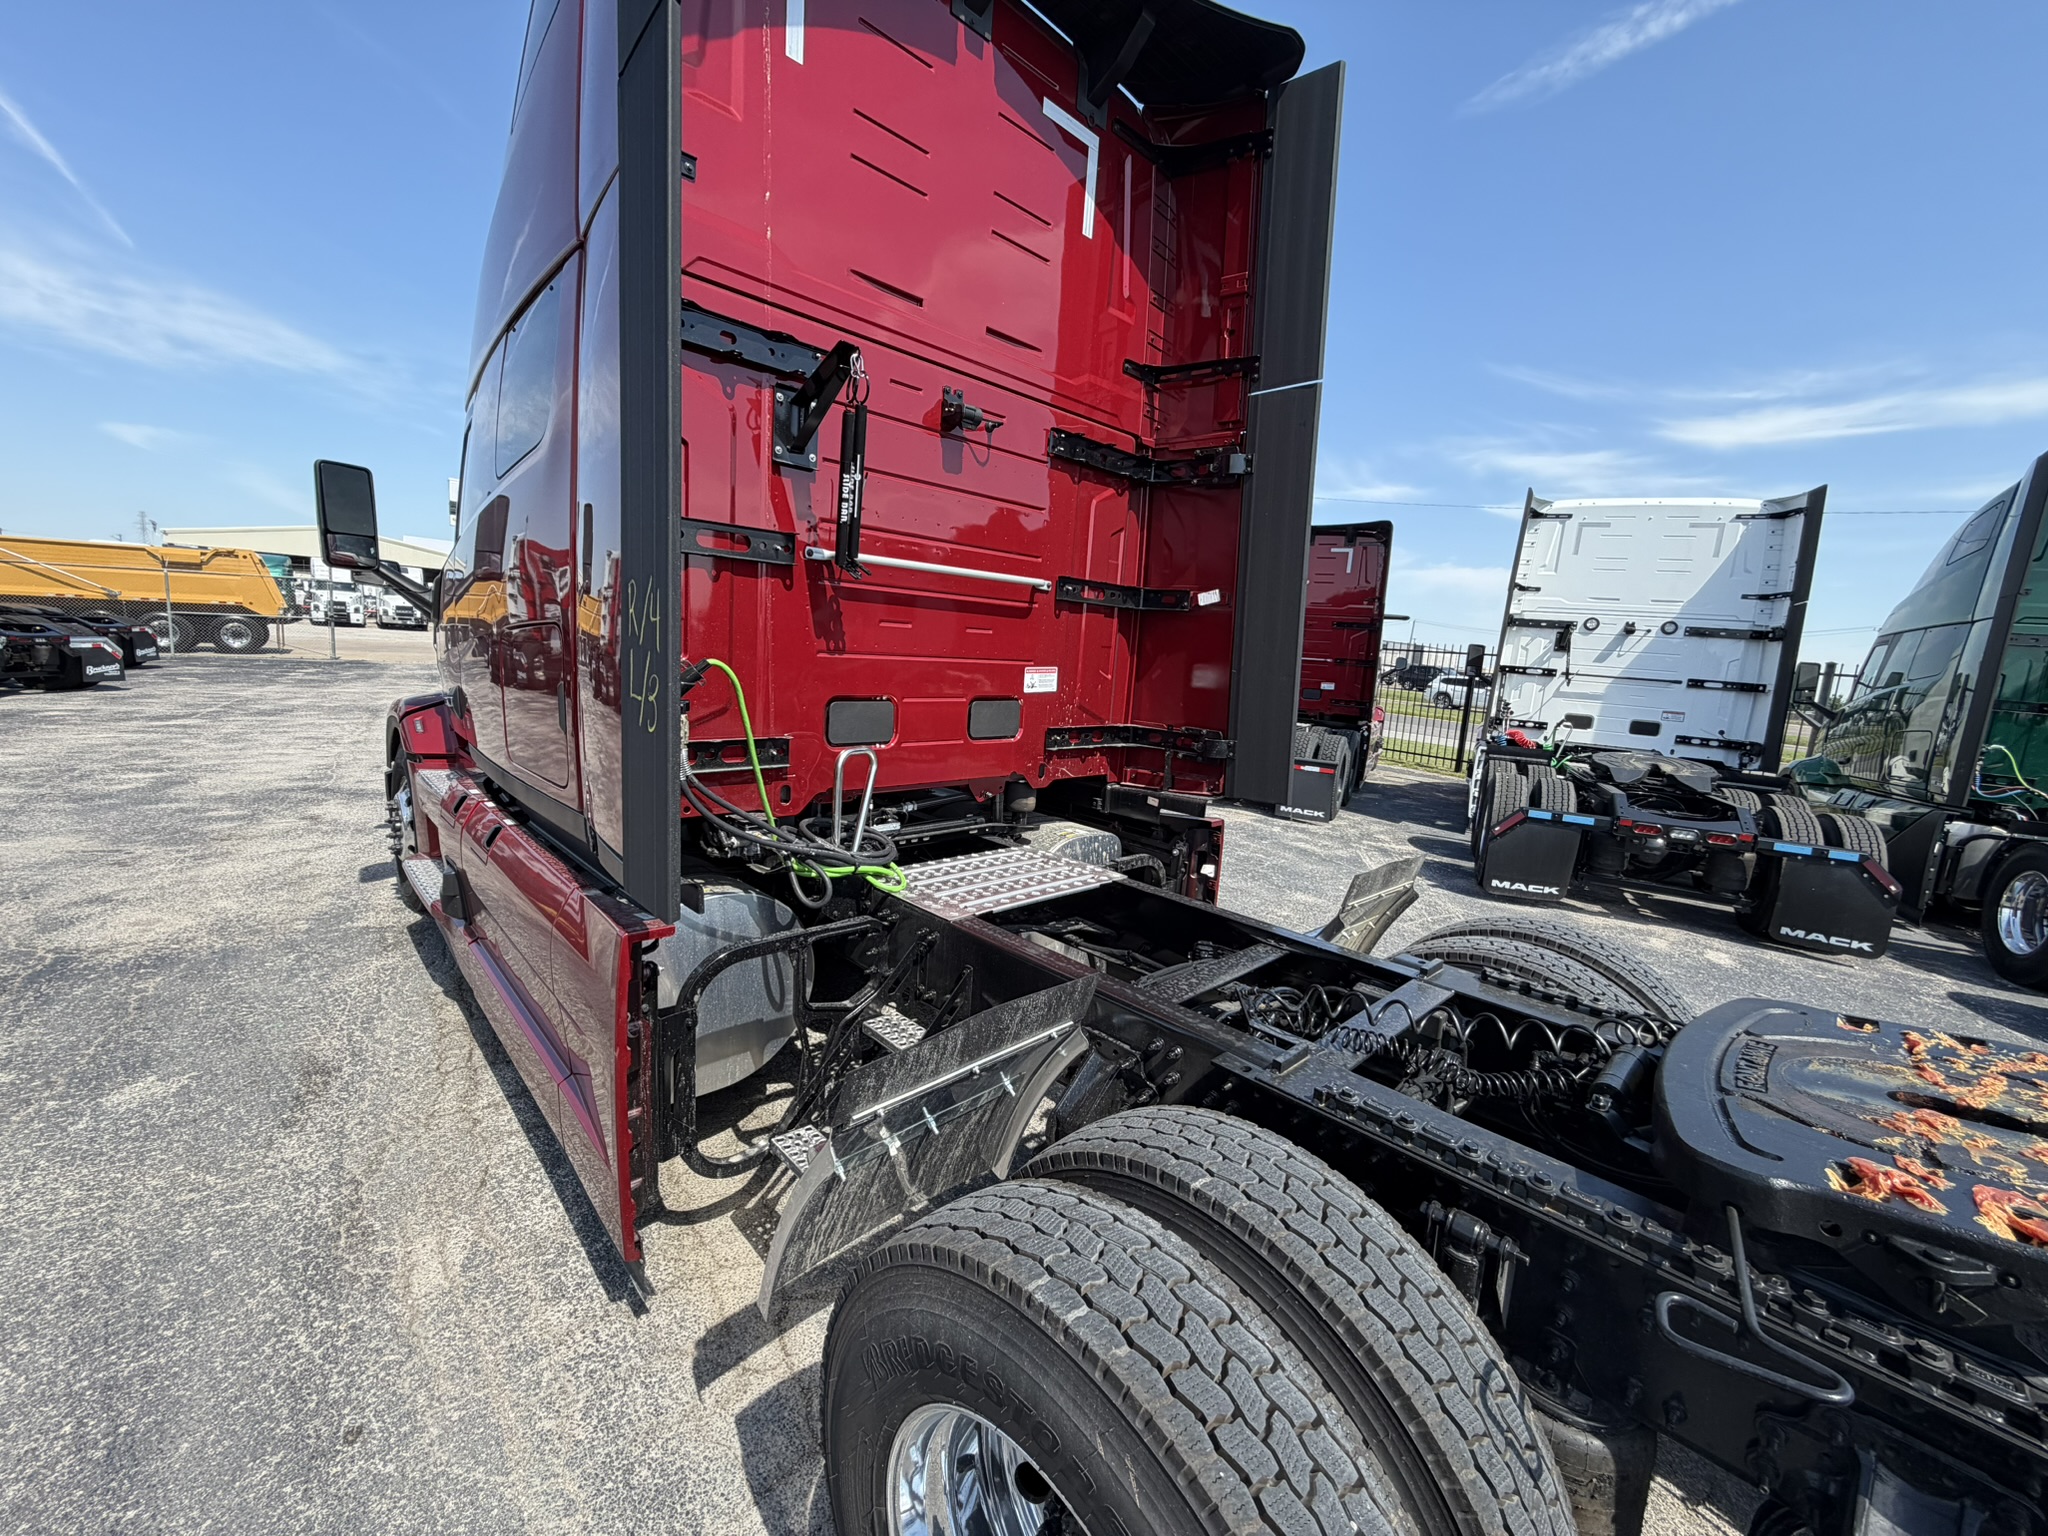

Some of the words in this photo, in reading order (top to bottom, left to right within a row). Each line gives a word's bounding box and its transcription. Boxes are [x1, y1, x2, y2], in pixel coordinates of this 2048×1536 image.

[628, 575, 660, 653] R/4
[630, 648, 659, 732] L/3
[1280, 805, 1325, 818] MACK
[1491, 879, 1560, 895] MACK
[1780, 926, 1874, 953] MACK
